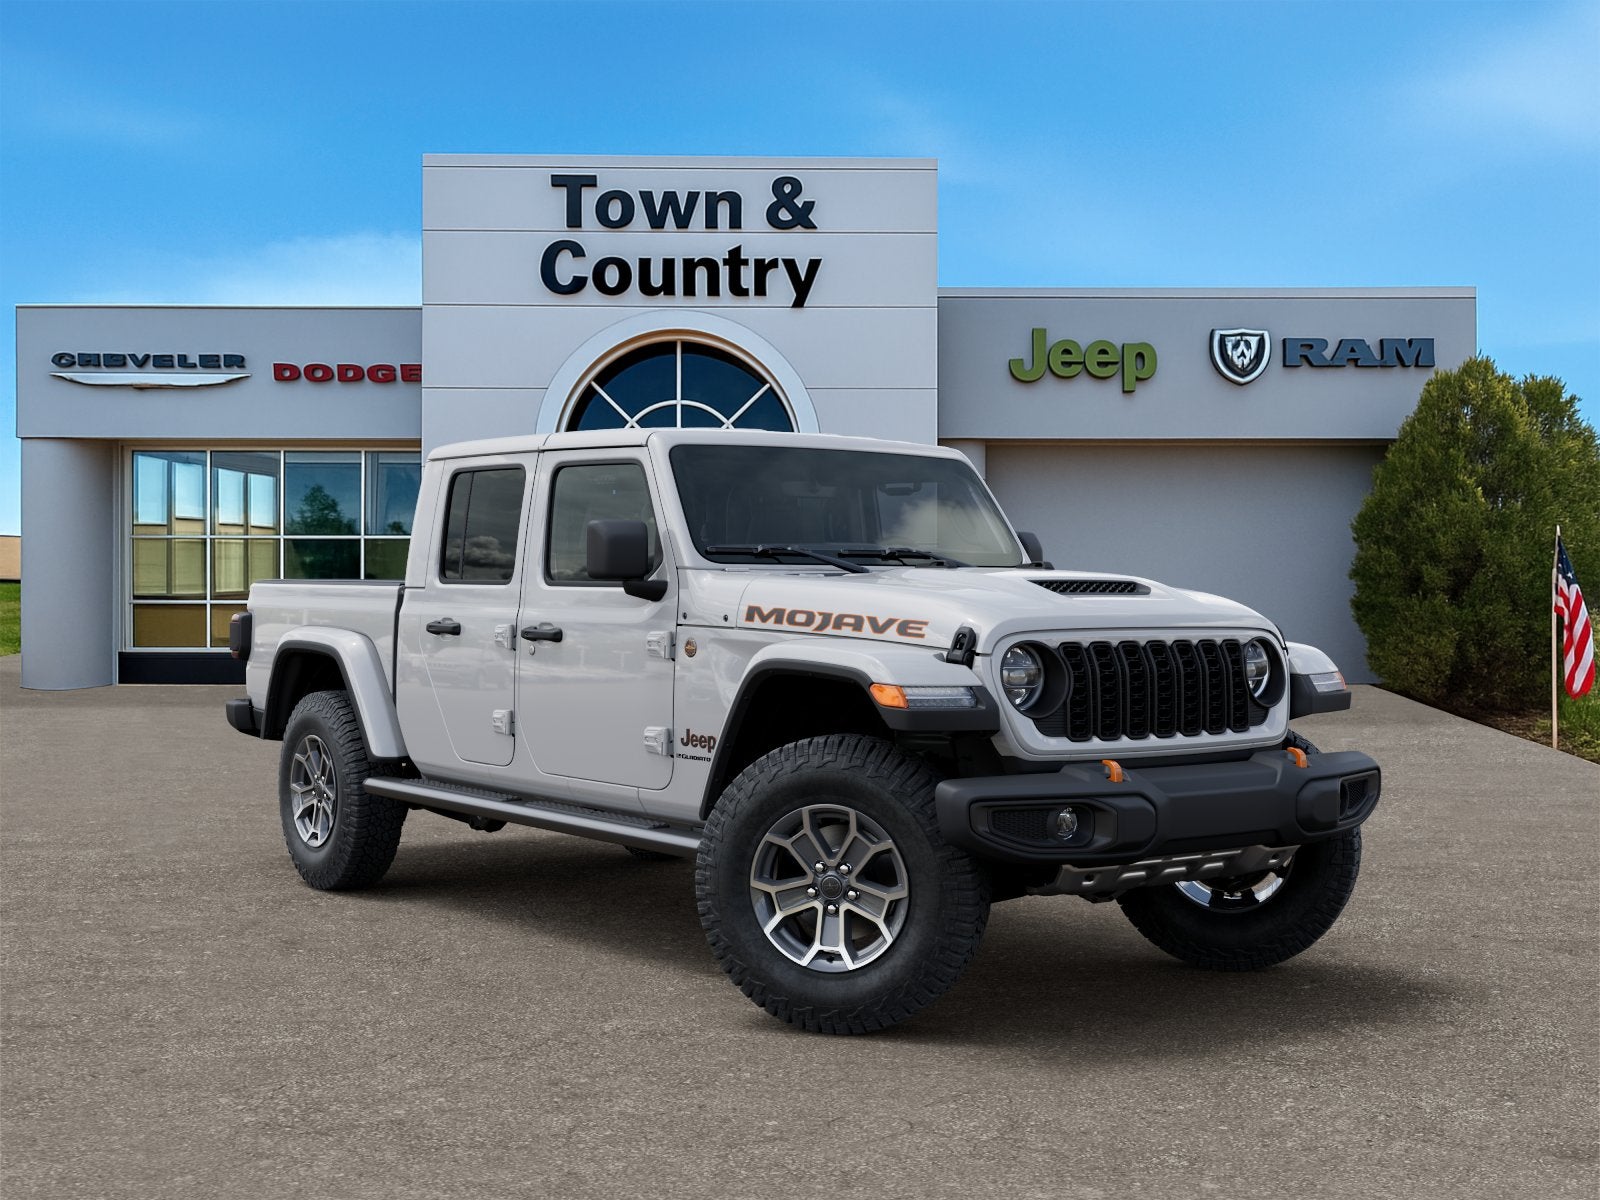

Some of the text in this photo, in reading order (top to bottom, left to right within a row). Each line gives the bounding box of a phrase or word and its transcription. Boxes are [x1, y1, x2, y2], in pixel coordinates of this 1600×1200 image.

[550, 174, 818, 230] Town &
[540, 239, 822, 308] Country
[1008, 328, 1157, 393] Jeep
[1282, 337, 1435, 368] RAM
[273, 363, 422, 383] DODGE
[744, 604, 930, 639] MOJAVE
[680, 728, 717, 754] Jeep
